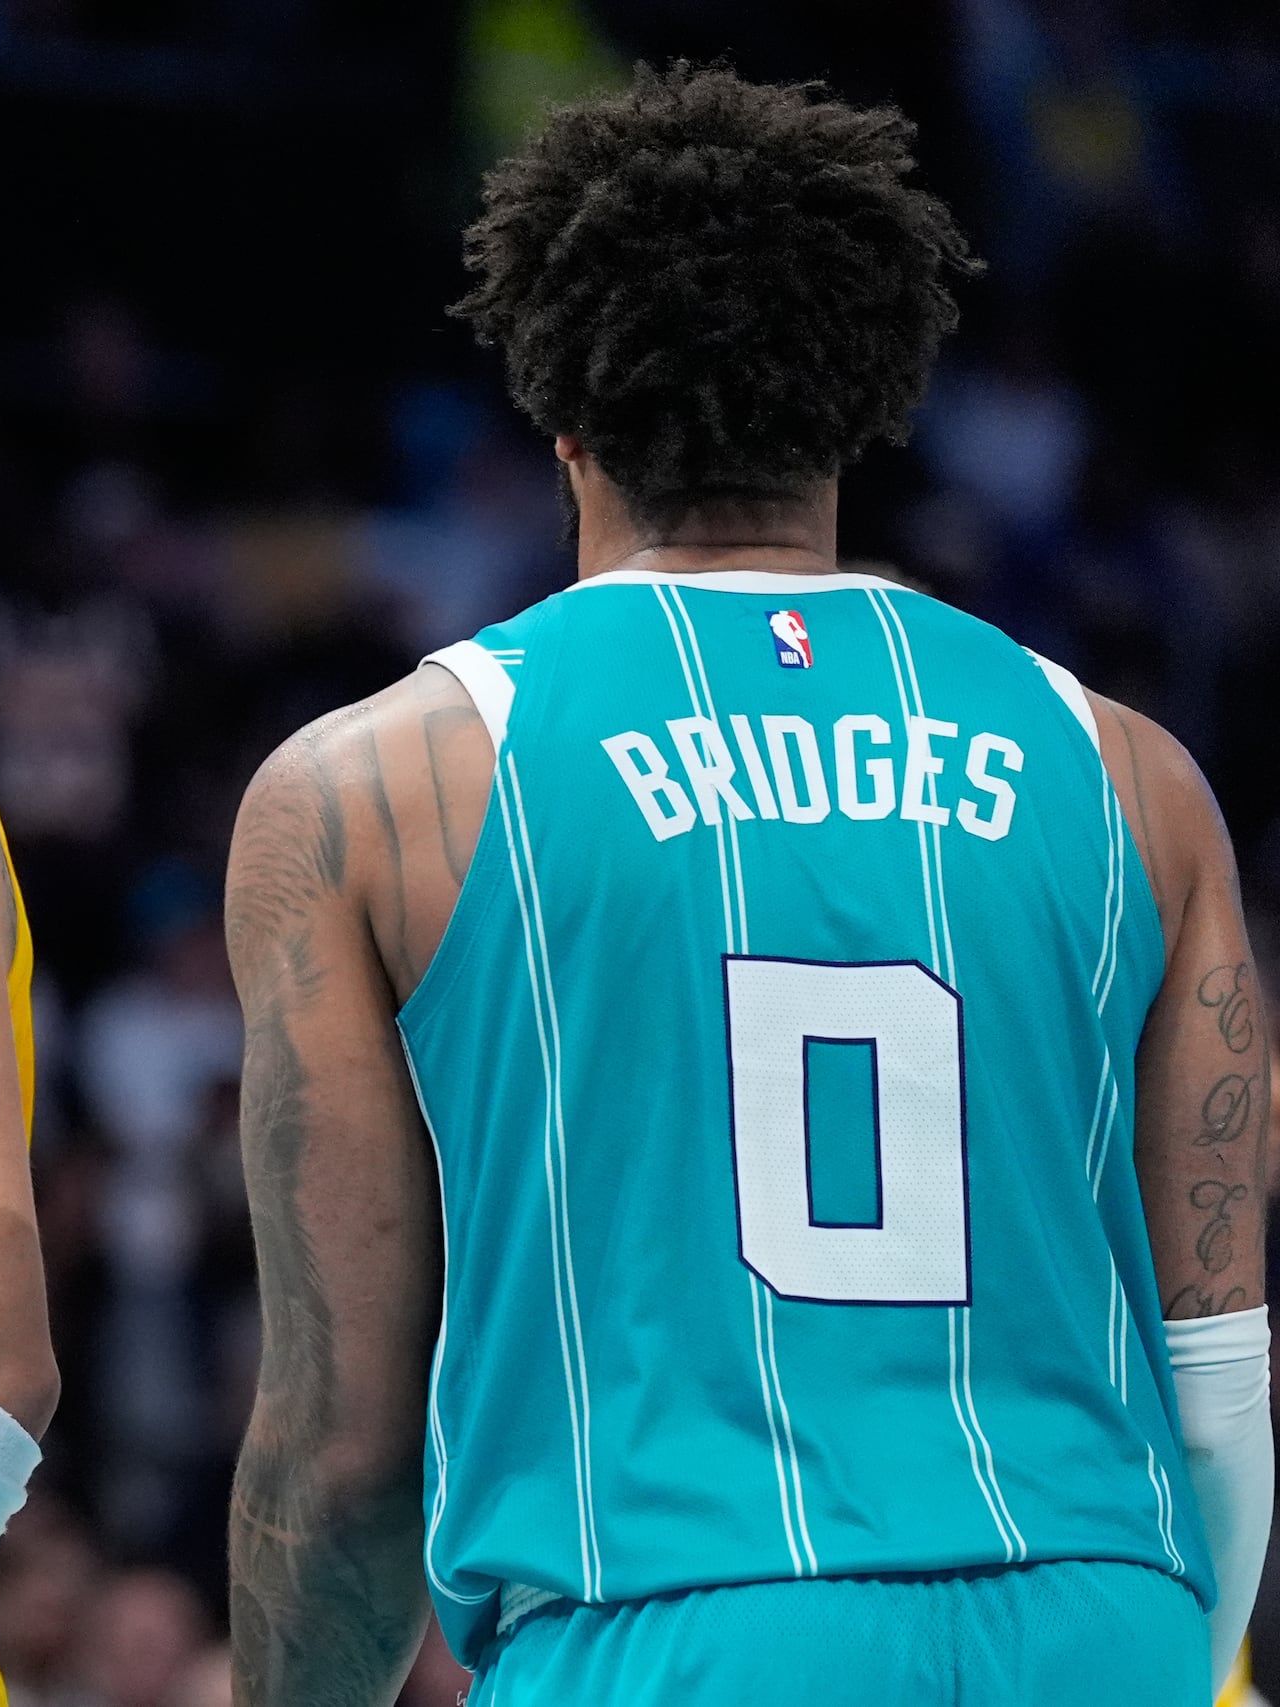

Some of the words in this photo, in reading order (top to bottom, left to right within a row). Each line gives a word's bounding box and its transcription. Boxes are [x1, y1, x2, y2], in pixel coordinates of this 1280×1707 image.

[780, 651, 801, 665] NBA
[600, 714, 1025, 842] BRIDGES
[721, 953, 972, 1307] 0
